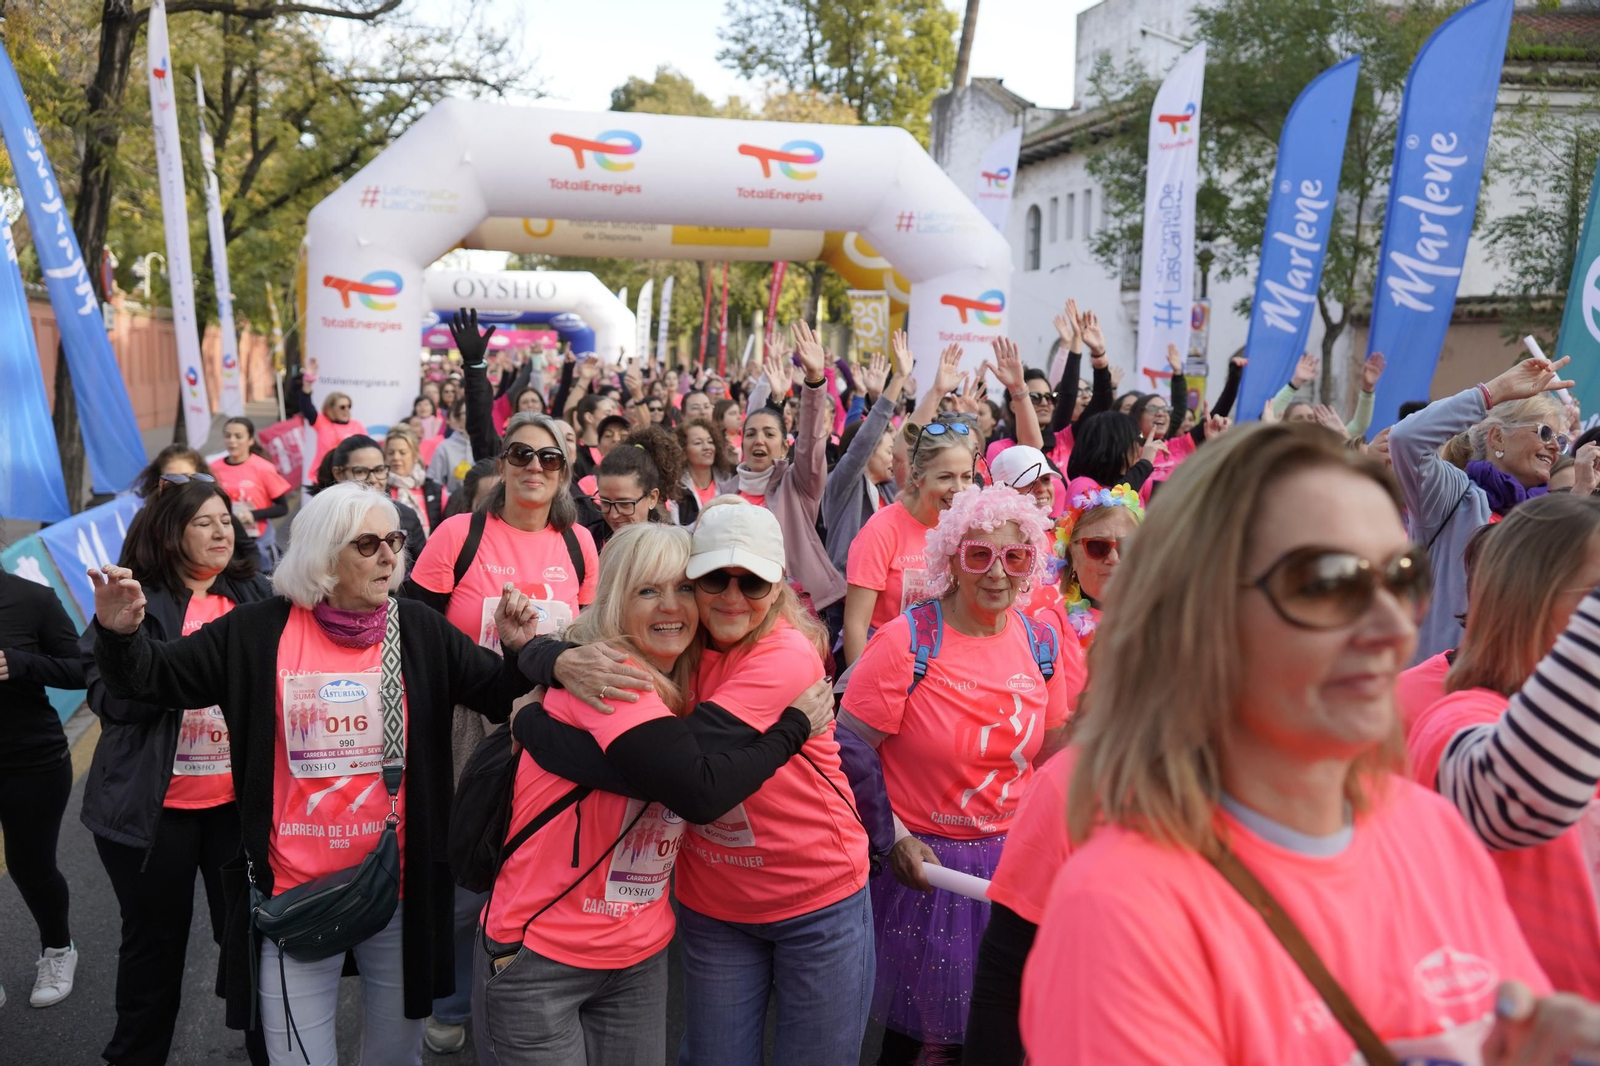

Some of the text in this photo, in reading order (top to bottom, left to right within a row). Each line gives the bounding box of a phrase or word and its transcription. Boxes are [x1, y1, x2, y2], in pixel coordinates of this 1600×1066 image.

[549, 178, 642, 195] TotalEnergies
[736, 187, 823, 202] TotalEnergies
[1387, 132, 1468, 312] Marlene
[1260, 179, 1329, 334] Marlene
[453, 277, 556, 300] OYSHO
[321, 317, 402, 332] TotalEnergies
[936, 677, 977, 691] OYSHO
[323, 688, 365, 698] ASTURIANA
[325, 715, 368, 733] 016
[339, 739, 355, 748] 990
[301, 763, 336, 772] OYSHO
[931, 811, 976, 827] CARRERA
[280, 823, 325, 837] CARRERA
[328, 825, 342, 837] DE
[346, 824, 359, 836] LA
[330, 839, 350, 849] 2025
[710, 851, 723, 864] LA
[724, 855, 764, 868] MUJER
[618, 886, 655, 897] OYSHO
